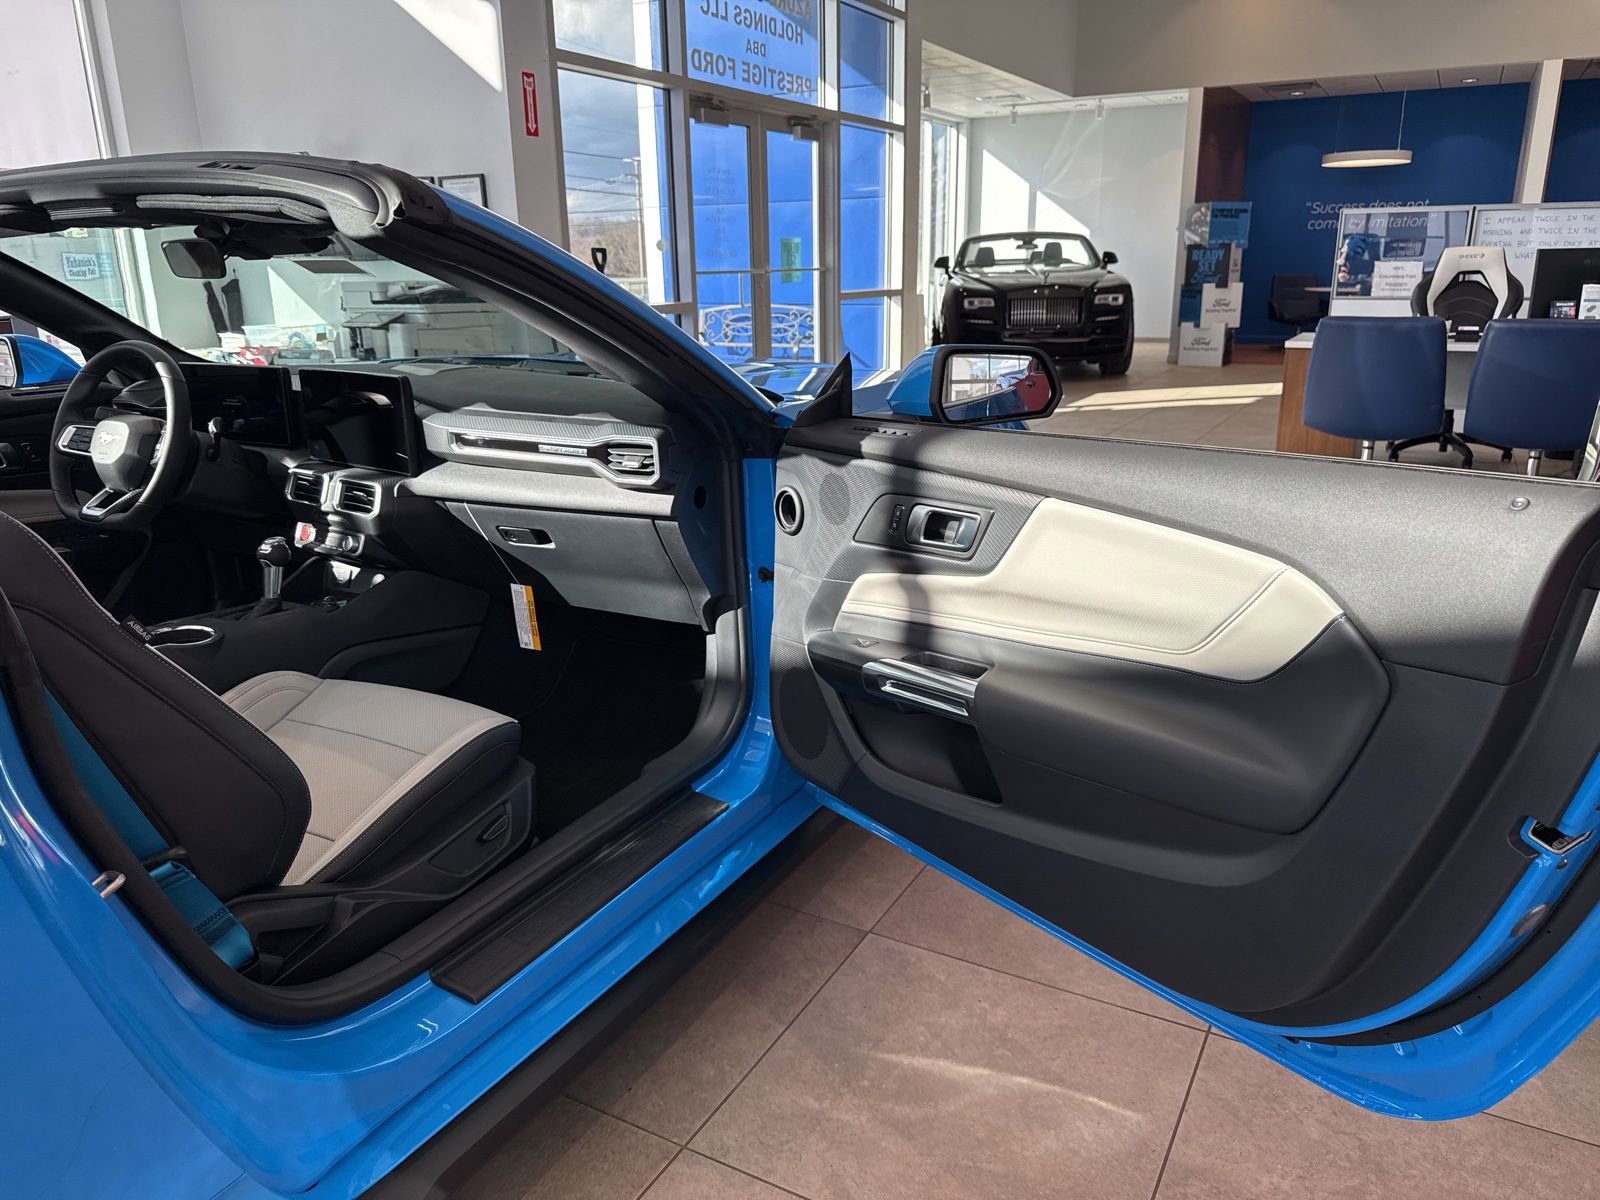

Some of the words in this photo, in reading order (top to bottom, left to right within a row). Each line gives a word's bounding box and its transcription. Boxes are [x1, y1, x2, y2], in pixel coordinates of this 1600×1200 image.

[1307, 219, 1340, 230] com
[1497, 216, 1526, 225] APPEAR
[1535, 215, 1561, 223] TWICE
[1482, 228, 1513, 236] MORNING
[1519, 228, 1533, 236] AND
[1538, 227, 1562, 235] TWICE
[1567, 227, 1580, 235] IN
[1584, 227, 1598, 235] THE
[1517, 240, 1532, 248] BUT
[1538, 240, 1559, 248] ONLY
[1563, 240, 1582, 248] ONCE
[1192, 249, 1225, 261] READY
[1514, 252, 1535, 260] WHAT
[1198, 260, 1217, 273] SET
[127, 620, 152, 641] AIRBAG
